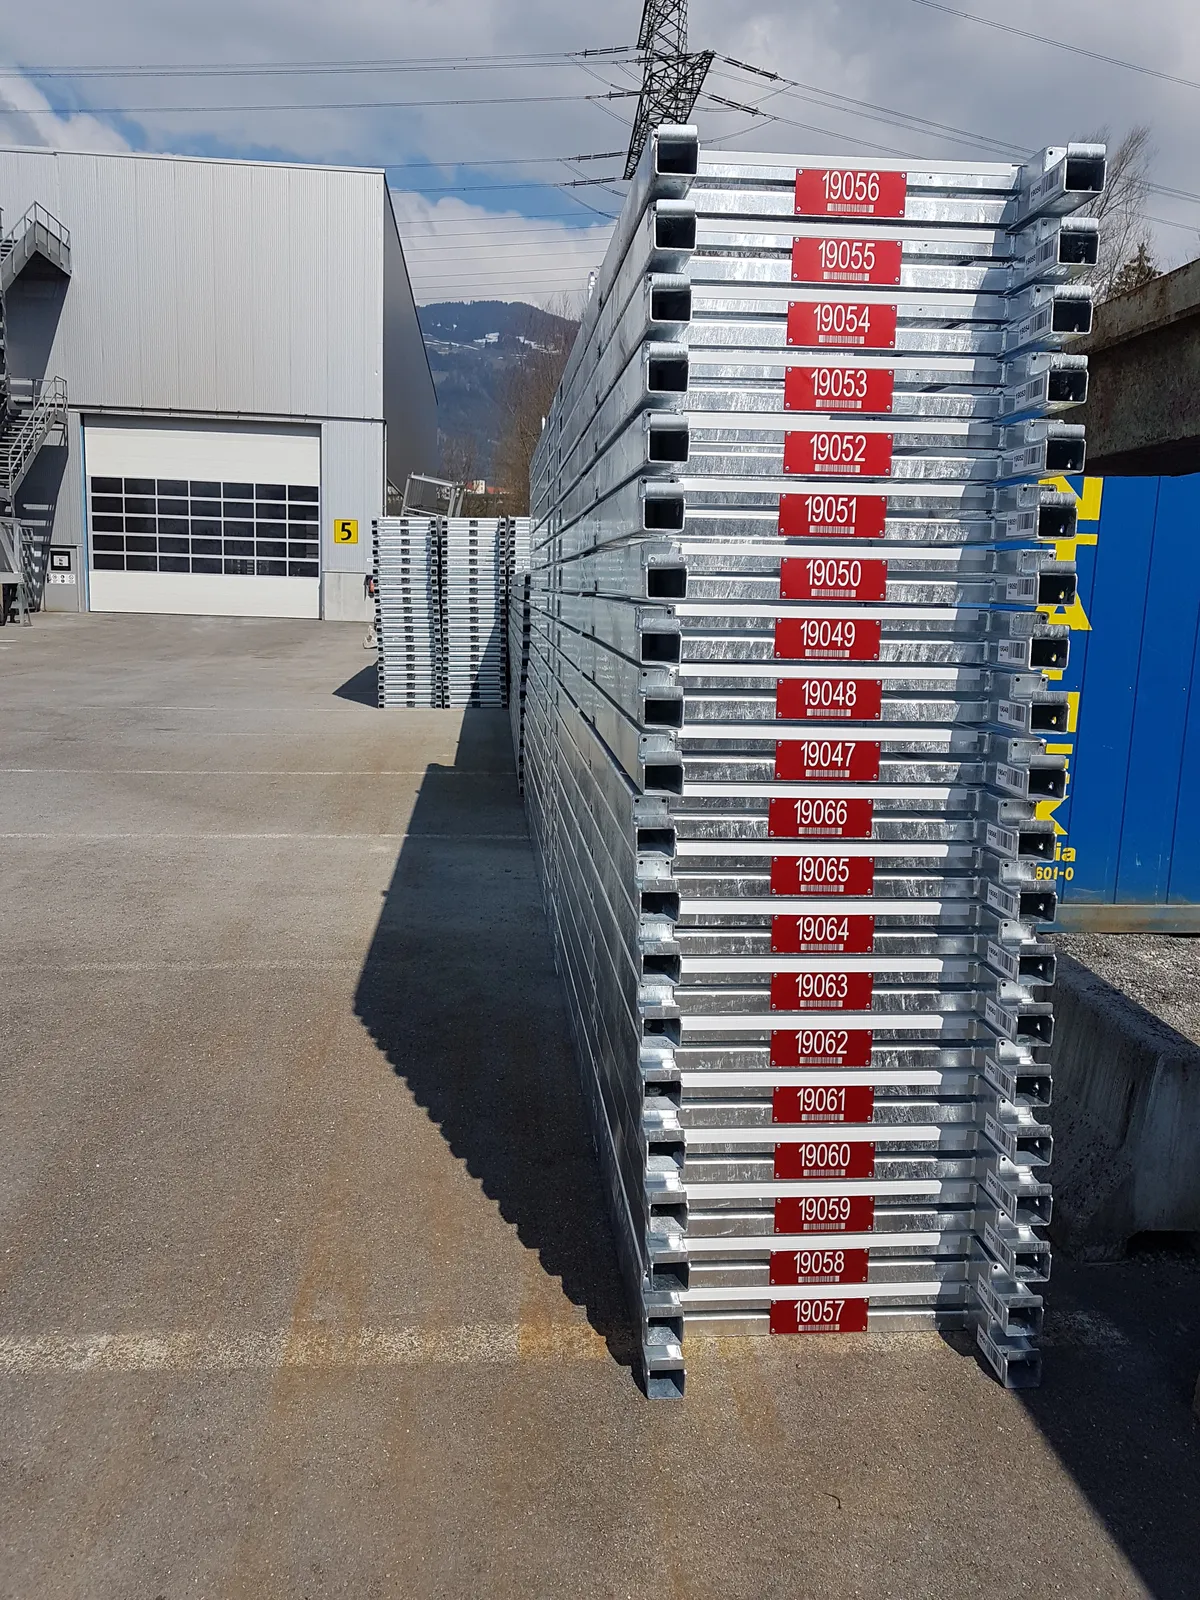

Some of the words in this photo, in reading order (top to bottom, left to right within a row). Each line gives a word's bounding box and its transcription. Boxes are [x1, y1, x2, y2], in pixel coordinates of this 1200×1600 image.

[821, 170, 880, 202] 19056
[818, 239, 876, 271] 19055
[813, 303, 871, 333] 19054
[810, 368, 868, 398] 19053
[809, 433, 867, 462] 19052
[804, 495, 857, 524] 19051
[340, 522, 352, 541] 5
[806, 559, 862, 587] 19050
[800, 620, 856, 648] 19049
[801, 680, 857, 707] 19048
[800, 741, 856, 767] 19047
[793, 799, 848, 825] 19066
[795, 856, 850, 883] 19065
[1036, 866, 1074, 881] 601-0
[796, 916, 850, 942] 19064
[795, 973, 848, 998] 19063
[795, 1030, 849, 1055] 19062
[796, 1087, 846, 1112] 19061
[798, 1143, 851, 1167] 19060
[798, 1197, 851, 1221] 19059
[793, 1250, 845, 1274] 19058
[793, 1300, 846, 1323] 19057
